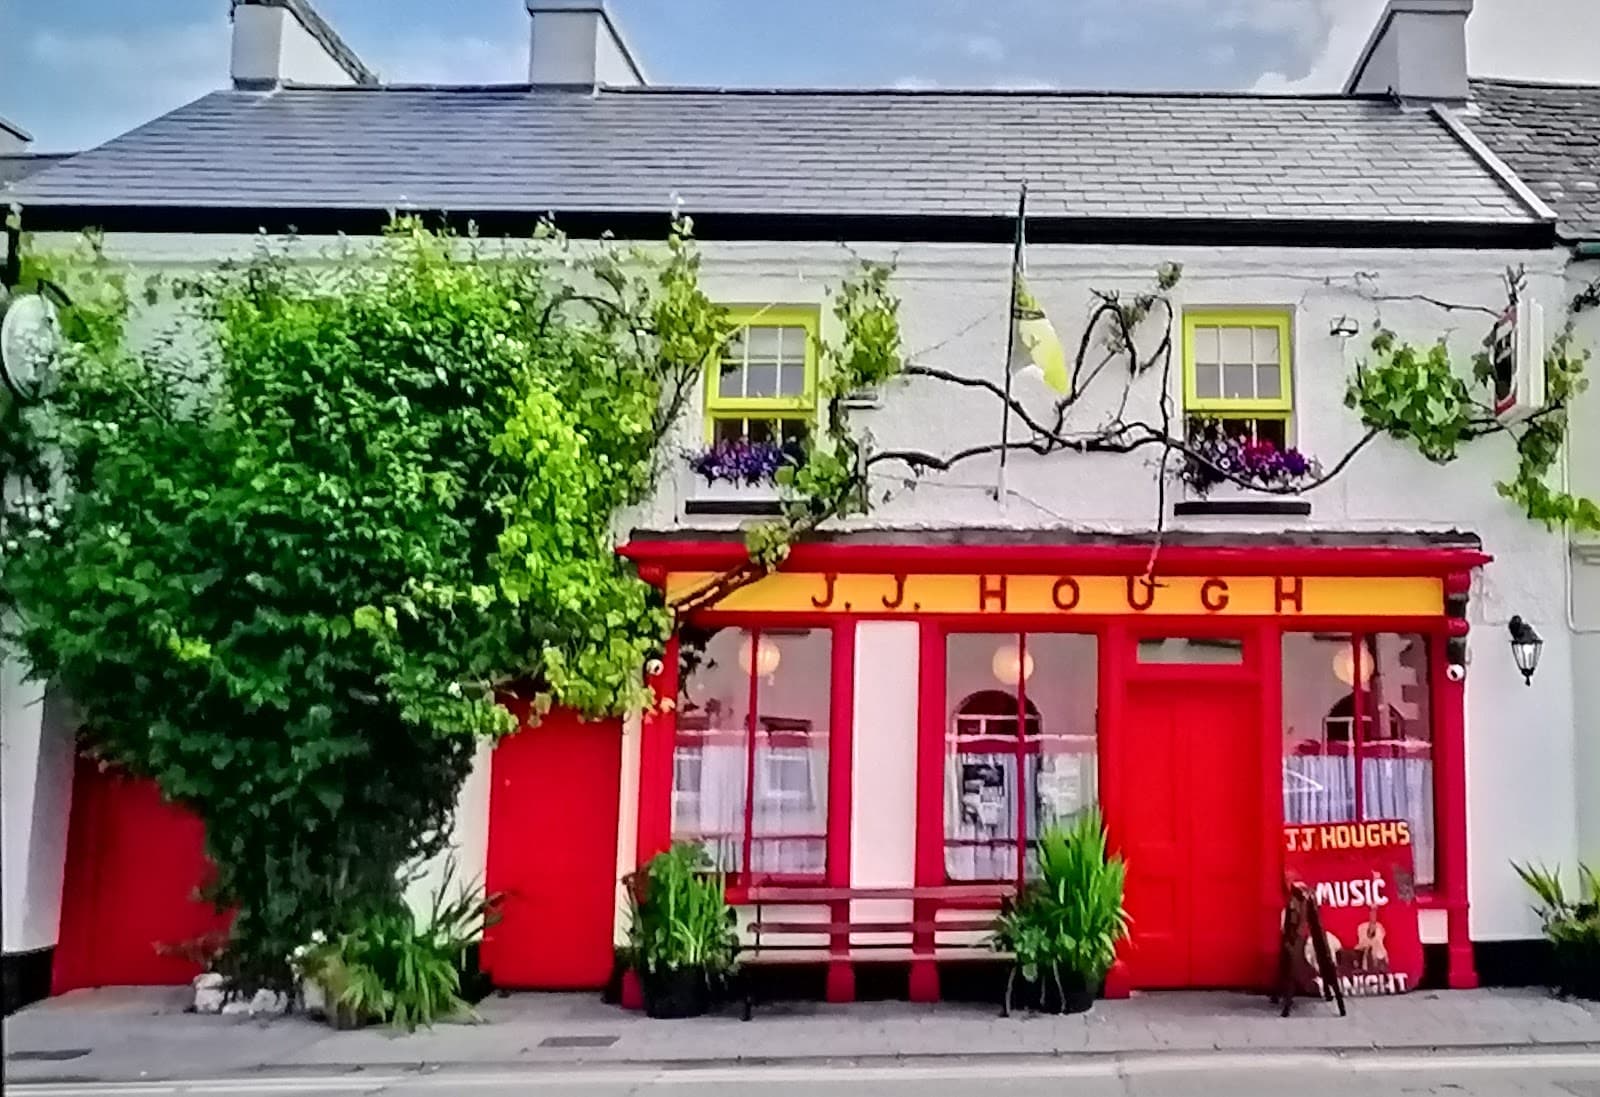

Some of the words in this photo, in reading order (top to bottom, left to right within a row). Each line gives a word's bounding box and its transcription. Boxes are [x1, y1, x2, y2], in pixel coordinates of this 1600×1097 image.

[978, 575, 1303, 612] HOUGH
[1320, 821, 1411, 850] HOUGHS
[1315, 878, 1389, 908] MUSIC
